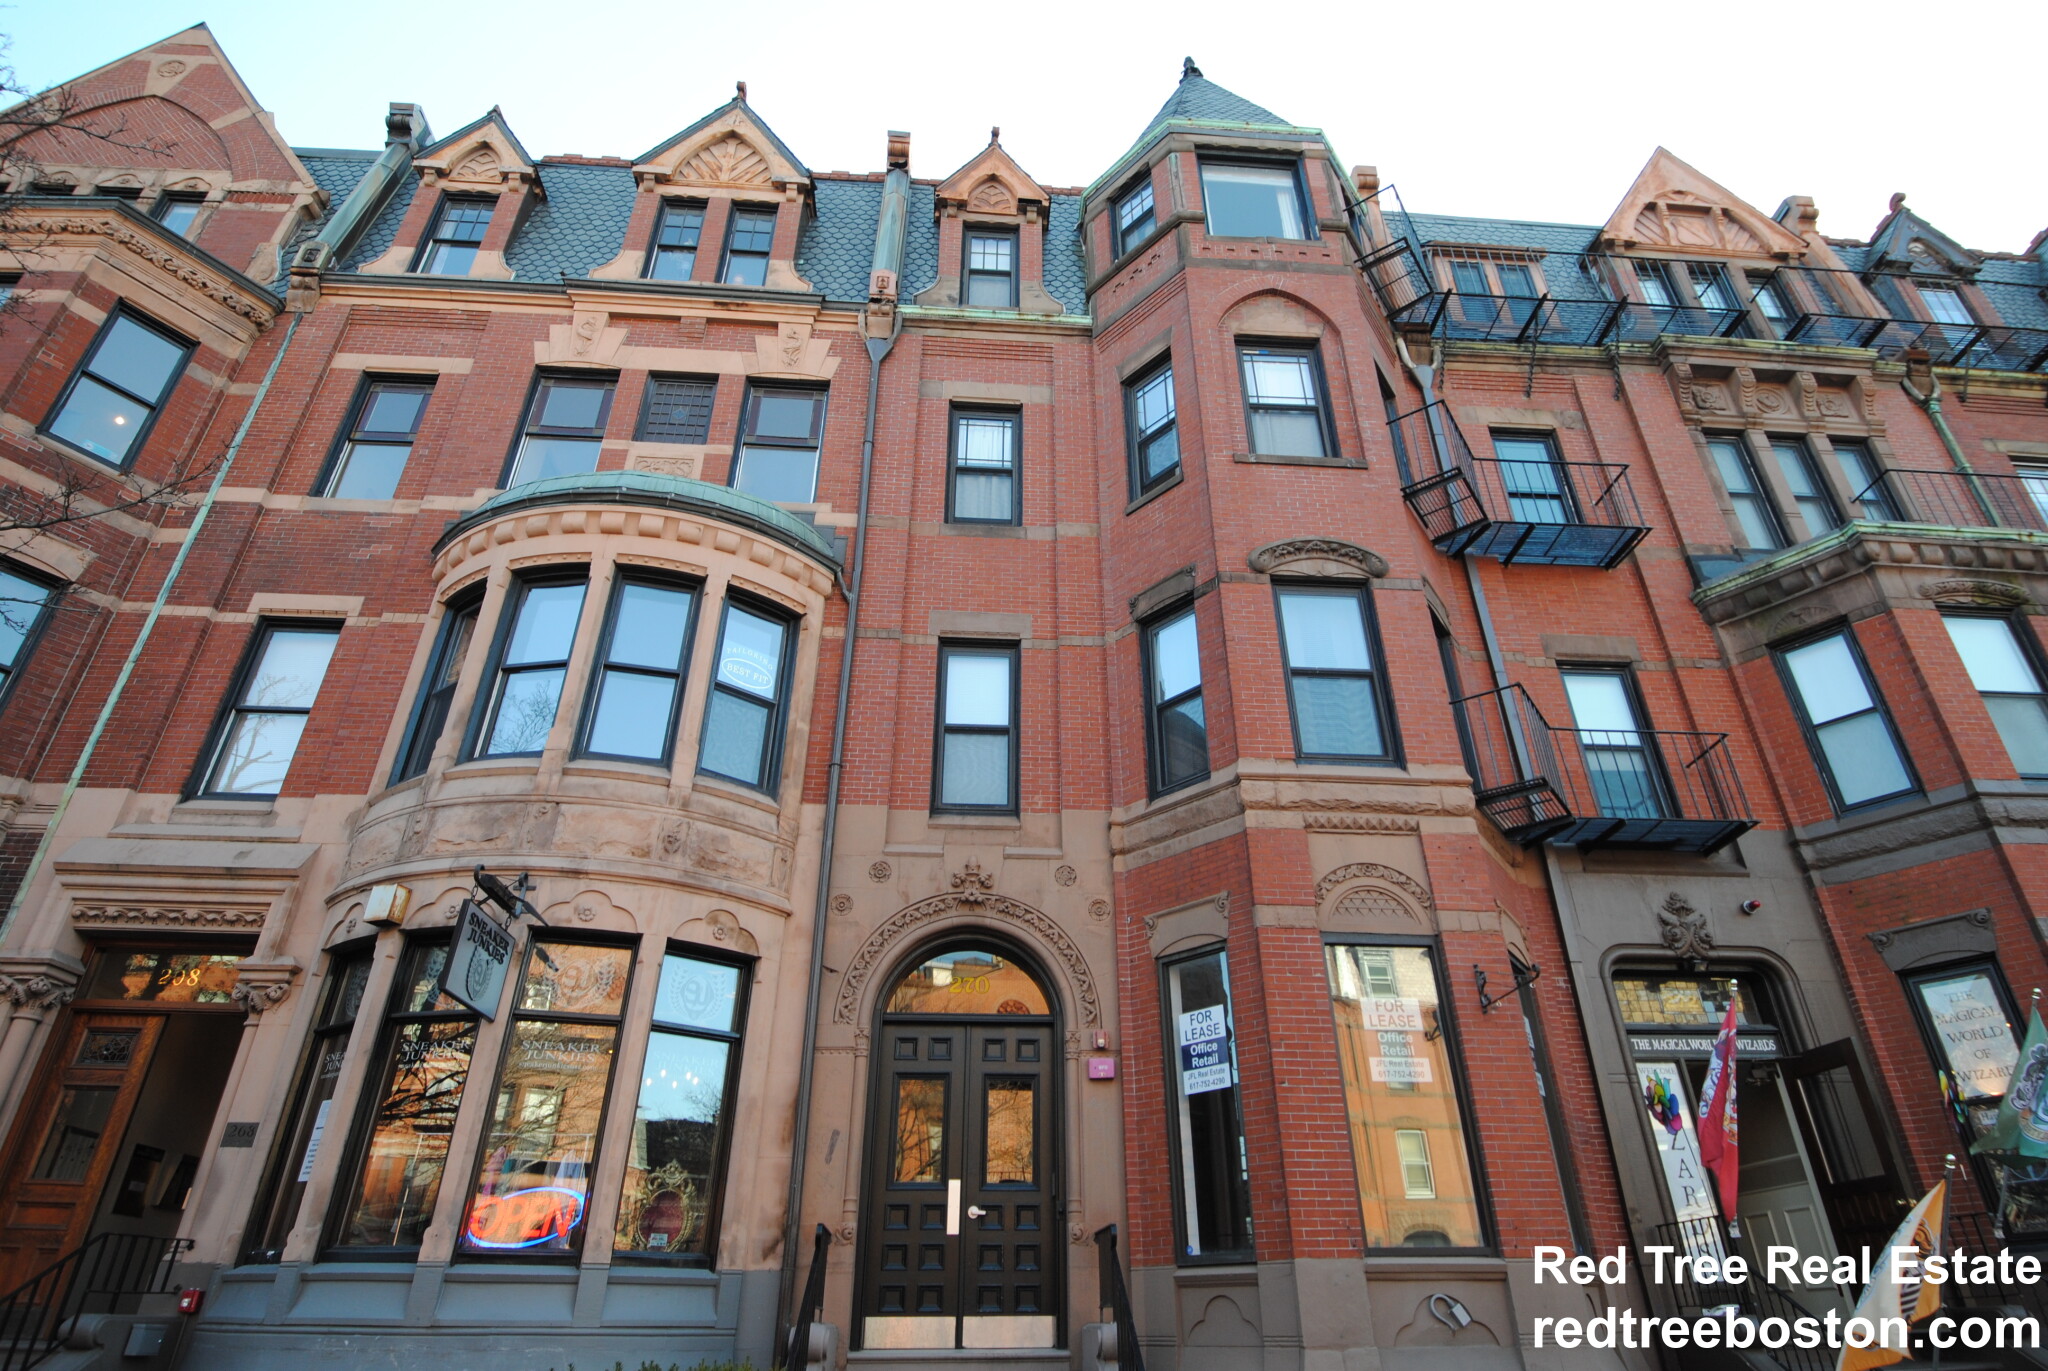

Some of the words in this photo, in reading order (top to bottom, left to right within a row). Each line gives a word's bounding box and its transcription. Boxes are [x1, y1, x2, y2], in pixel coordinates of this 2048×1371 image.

[726, 647, 773, 670] TAILORING
[727, 663, 751, 678] BEST
[753, 673, 769, 684] FIT
[469, 912, 510, 955] SNEAKER
[467, 927, 506, 965] JUNKIES
[949, 975, 991, 995] 270
[1944, 991, 1975, 1003] THE
[1375, 1001, 1404, 1012] FOR
[1190, 1010, 1212, 1026] FOR
[1369, 1014, 1416, 1028] LEASE
[1936, 1006, 2001, 1025] MAGICAL
[1185, 1023, 1221, 1042] LEASE
[1378, 1032, 1413, 1043] Office
[1946, 1025, 2004, 1043] WORLD
[401, 1040, 469, 1052] SNEAKER
[522, 1040, 599, 1052] SNEAKER
[1190, 1042, 1218, 1055] Office
[1381, 1044, 1415, 1056] Retail
[1631, 1038, 1651, 1050] THE
[1651, 1038, 1690, 1050] MAGICAL
[1735, 1039, 1776, 1051] WIZARDS
[524, 1050, 595, 1062] JUNKIES
[1192, 1053, 1219, 1068] Retail
[1974, 1049, 1992, 1060] OF
[1198, 1069, 1209, 1078] Real
[1210, 1067, 1225, 1076] Estate
[1957, 1065, 2015, 1081] WIZARD
[228, 1124, 256, 1138] 268
[470, 1197, 577, 1238] OPEN
